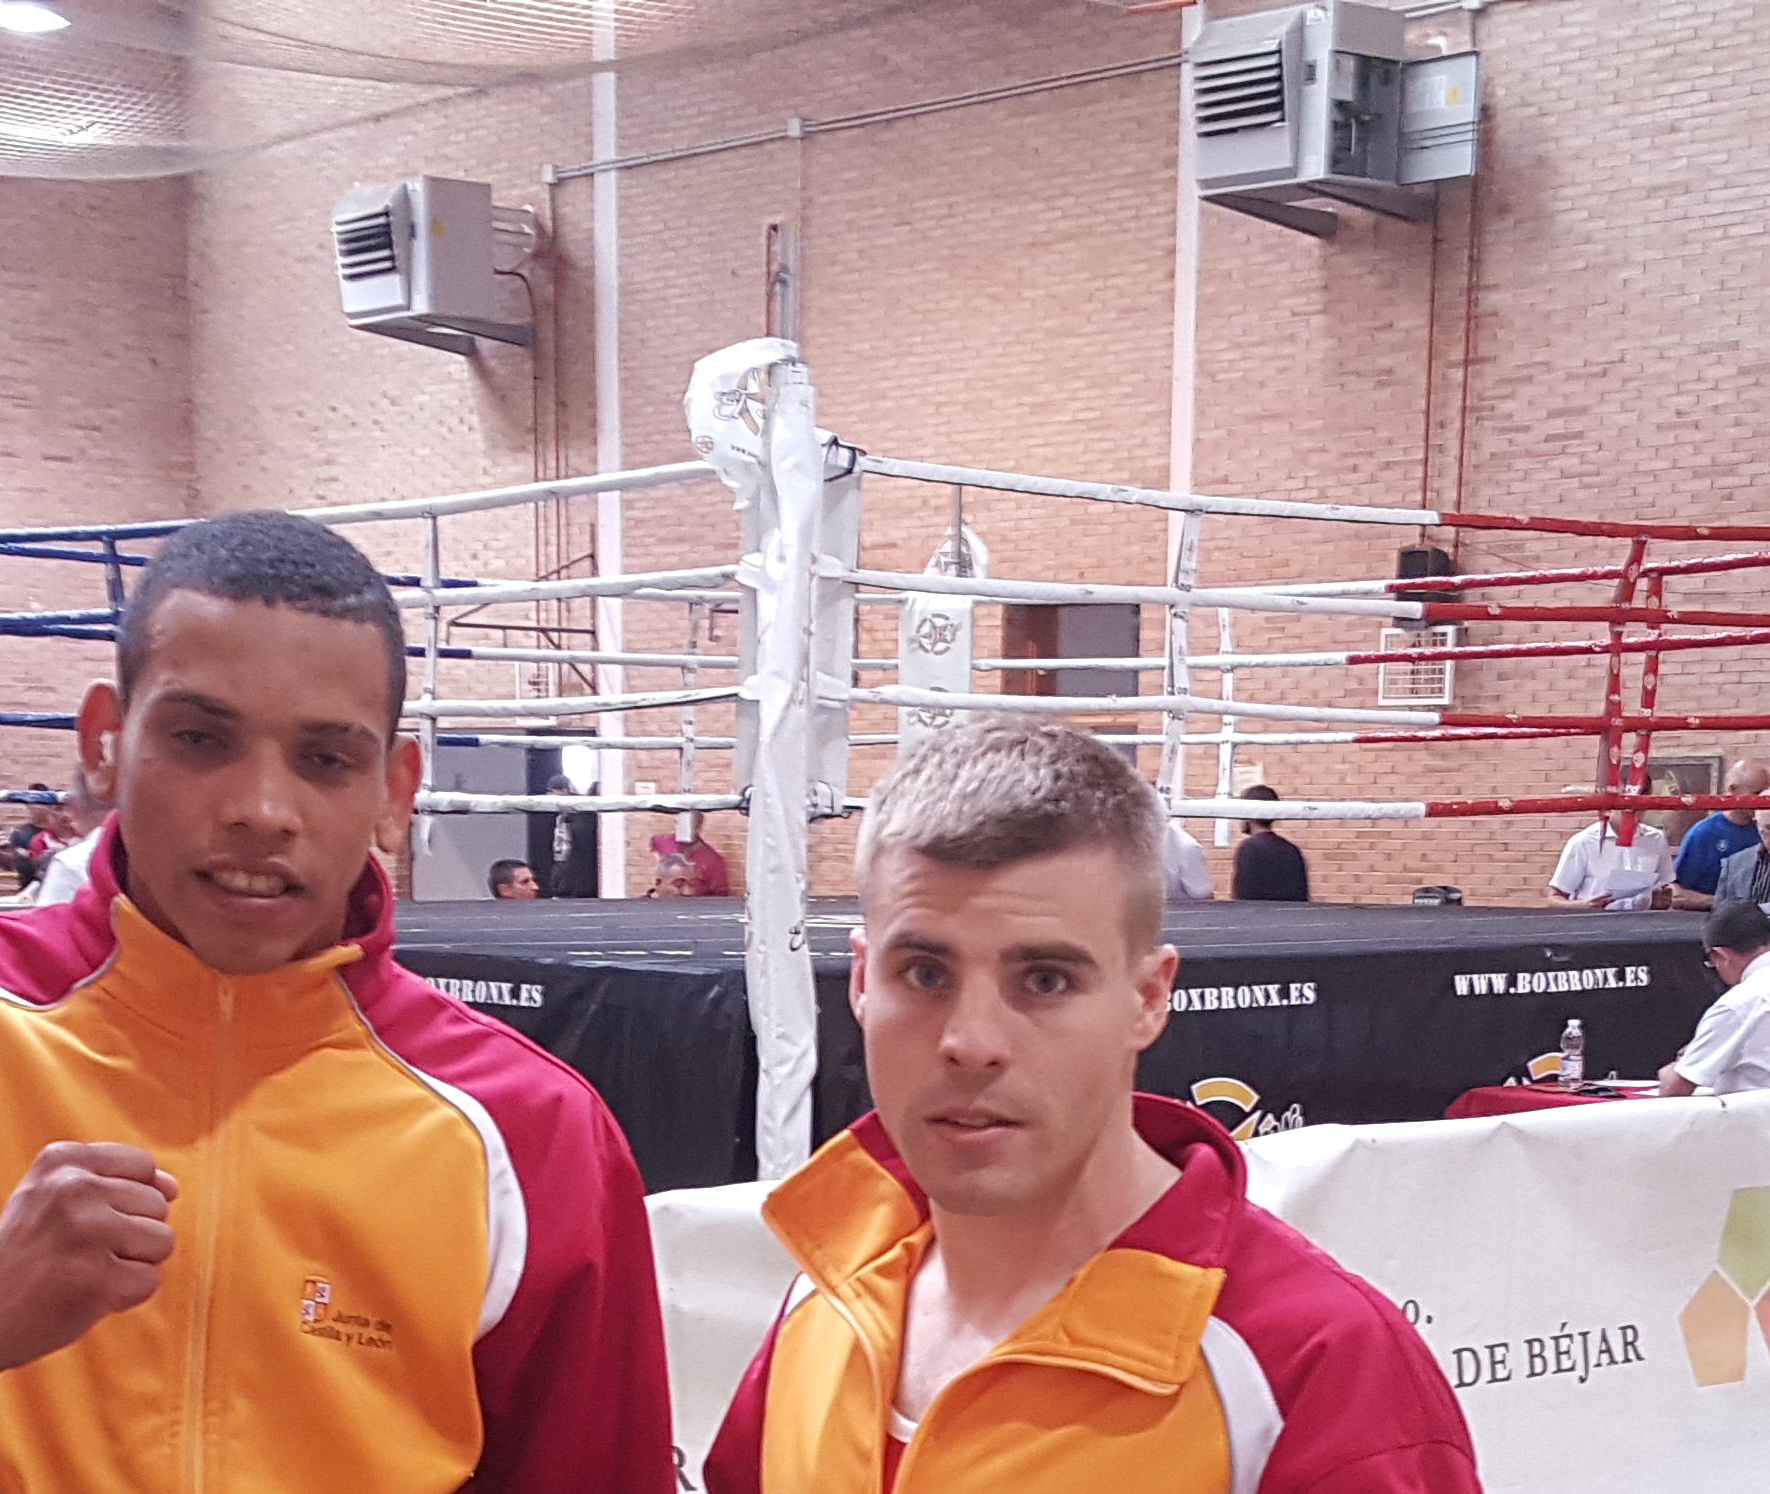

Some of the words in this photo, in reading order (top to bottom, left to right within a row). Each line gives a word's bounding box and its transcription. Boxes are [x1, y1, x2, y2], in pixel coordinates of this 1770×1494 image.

[1454, 966, 1650, 996] WWW.BOXBRONX.ES
[1452, 1342, 1513, 1389] DE
[1523, 1321, 1646, 1384] BÉJAR
